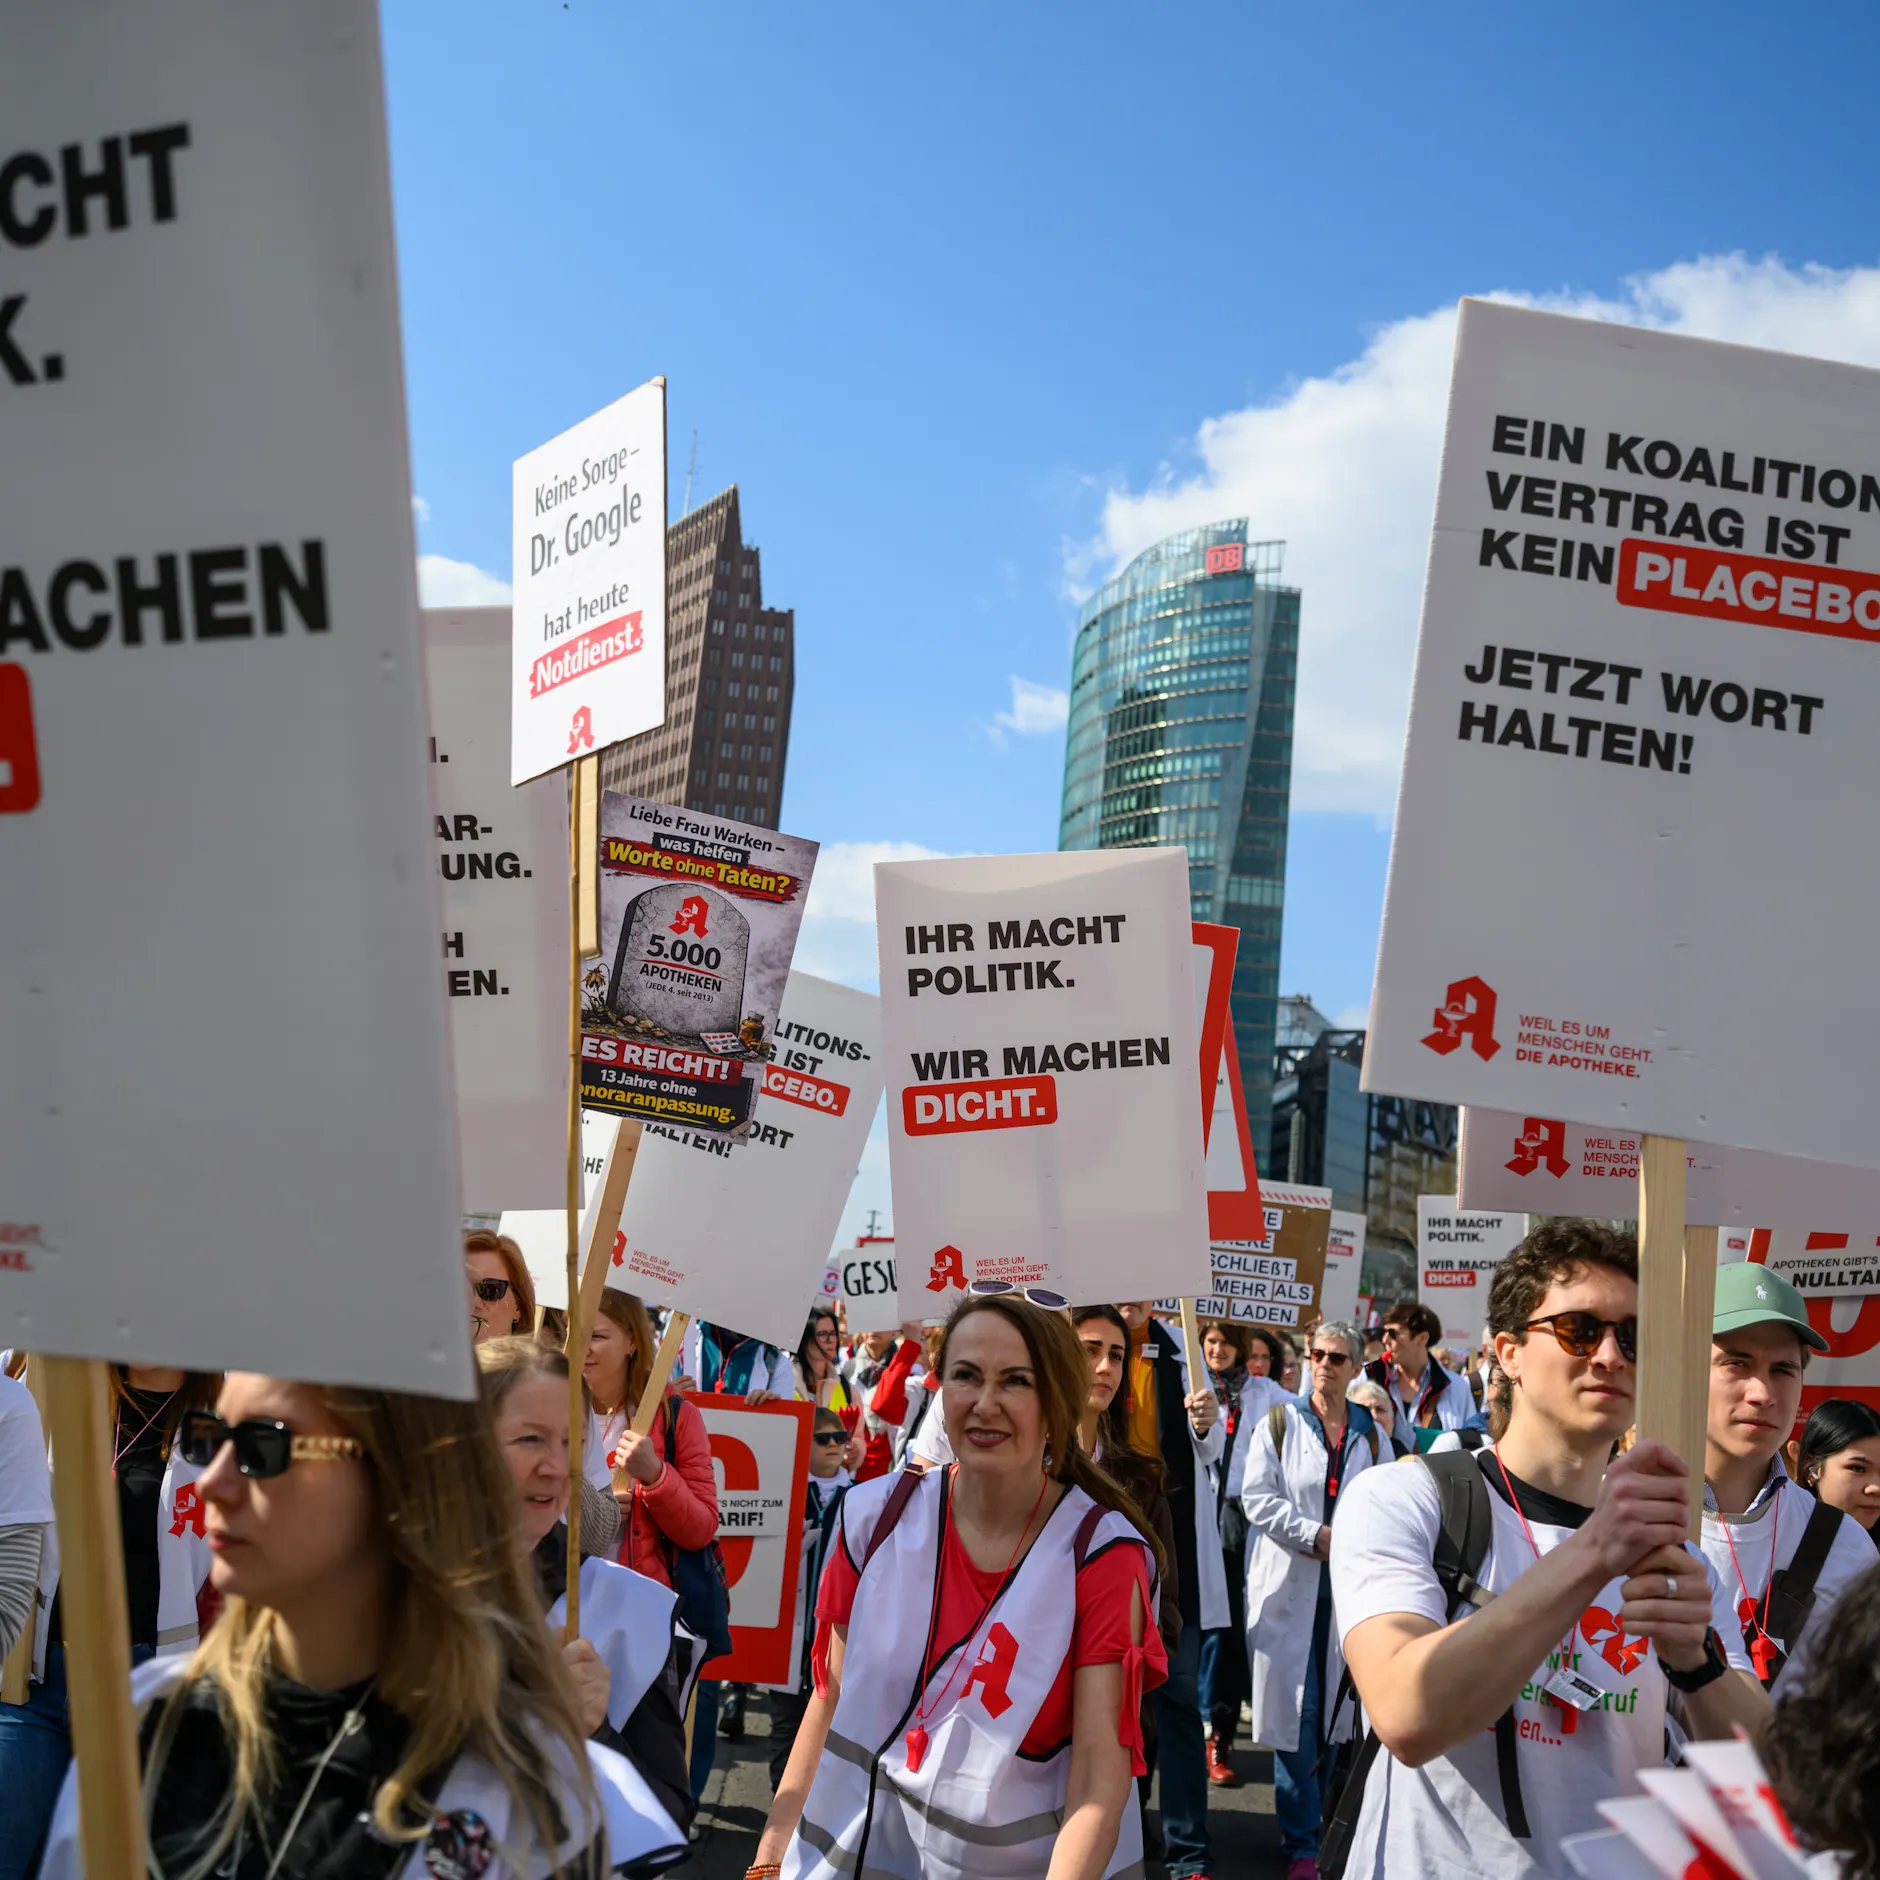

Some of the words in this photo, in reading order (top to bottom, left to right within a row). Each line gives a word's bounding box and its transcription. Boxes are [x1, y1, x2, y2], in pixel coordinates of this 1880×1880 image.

[0, 121, 191, 250] CHT
[1492, 415, 1585, 464] EIN
[535, 474, 577, 517] Keine
[531, 533, 559, 576] Dr.
[565, 483, 641, 556] Google
[1486, 471, 1745, 548] VERTRAG
[1765, 516, 1851, 564] IST
[1479, 528, 1615, 585] KEIN
[1633, 551, 1880, 630] PLACEBO
[0, 537, 331, 656] ACHEN
[544, 606, 572, 642] hat
[578, 583, 629, 625] heute
[536, 621, 642, 692] Notdienst.
[1465, 645, 1642, 705] JETZT
[1661, 672, 1824, 735] WORT
[1458, 701, 1694, 775] HALTEN!
[629, 805, 673, 827] Liebe
[676, 816, 711, 837] Frau
[714, 825, 772, 852] Warken
[659, 837, 691, 853] was
[693, 841, 742, 864] helfen
[441, 852, 532, 881] UNG.
[609, 841, 673, 871] Worte
[675, 859, 715, 878] ohne
[716, 863, 790, 894] Taten?
[905, 923, 974, 955] IHR
[988, 914, 1126, 950] MACHT
[646, 934, 721, 970] 5.000
[640, 963, 722, 992] APOTHEKEN
[645, 981, 667, 992] (JEDE
[668, 986, 675, 994] 4.
[677, 989, 691, 998] seit
[693, 992, 714, 1003] 2013)
[908, 960, 1075, 997] POLITIK.
[774, 1018, 871, 1061] LITIONS-
[1520, 1014, 1556, 1031] WEIL
[1562, 1021, 1580, 1035] ES
[1585, 1024, 1610, 1040] UM
[581, 1037, 618, 1061] ES
[623, 1043, 730, 1080] REICHT!
[783, 1049, 823, 1075] IST
[910, 1049, 989, 1081] WIR
[1002, 1036, 1171, 1076] MACHEN
[1517, 1032, 1605, 1056] MENSCHEN
[1609, 1045, 1653, 1063] GEHT.
[1516, 1048, 1544, 1063] DIE
[1548, 1053, 1640, 1078] APOTHEKE.
[600, 1069, 617, 1083] 13
[617, 1072, 657, 1090] Jahre
[660, 1081, 697, 1097] ohne
[914, 1088, 1046, 1124] DICHT.
[748, 1120, 794, 1149] ORT
[1585, 1138, 1615, 1149] WEIL
[1620, 1140, 1636, 1151] ES
[1582, 1165, 1605, 1176] DIE
[1609, 1167, 1640, 1178] APO
[1428, 1218, 1451, 1228] IHR
[1456, 1218, 1503, 1229] MACHT
[1428, 1232, 1485, 1243] POLITIK.
[631, 1257, 666, 1274] MENSCHEN
[633, 1250, 648, 1260] WEIL
[650, 1255, 658, 1263] ES
[659, 1258, 670, 1267] UM
[976, 1259, 996, 1267] WEIL
[998, 1257, 1009, 1265] ES
[1011, 1256, 1025, 1264] UM
[976, 1266, 1024, 1276] MENSCHEN
[1026, 1264, 1050, 1272] GEHT.
[1428, 1260, 1454, 1270] WIR
[1772, 1258, 1840, 1270] APOTHEKEN
[1843, 1256, 1879, 1267] GIBT'S
[628, 1264, 640, 1272] DIE
[641, 1268, 678, 1285] APOTHEKE.
[1427, 1274, 1473, 1285] DICHT.
[1792, 1269, 1880, 1288] NULLTA
[1215, 1279, 1266, 1297] MEHR
[1275, 1284, 1310, 1300] ALS
[1152, 1299, 1180, 1309] NU
[1195, 1299, 1224, 1315] EIN
[1231, 1303, 1296, 1324] LADEN.
[730, 1499, 759, 1508] NICHT
[762, 1499, 783, 1508] ZUM
[1590, 1688, 1639, 1713] ruf
